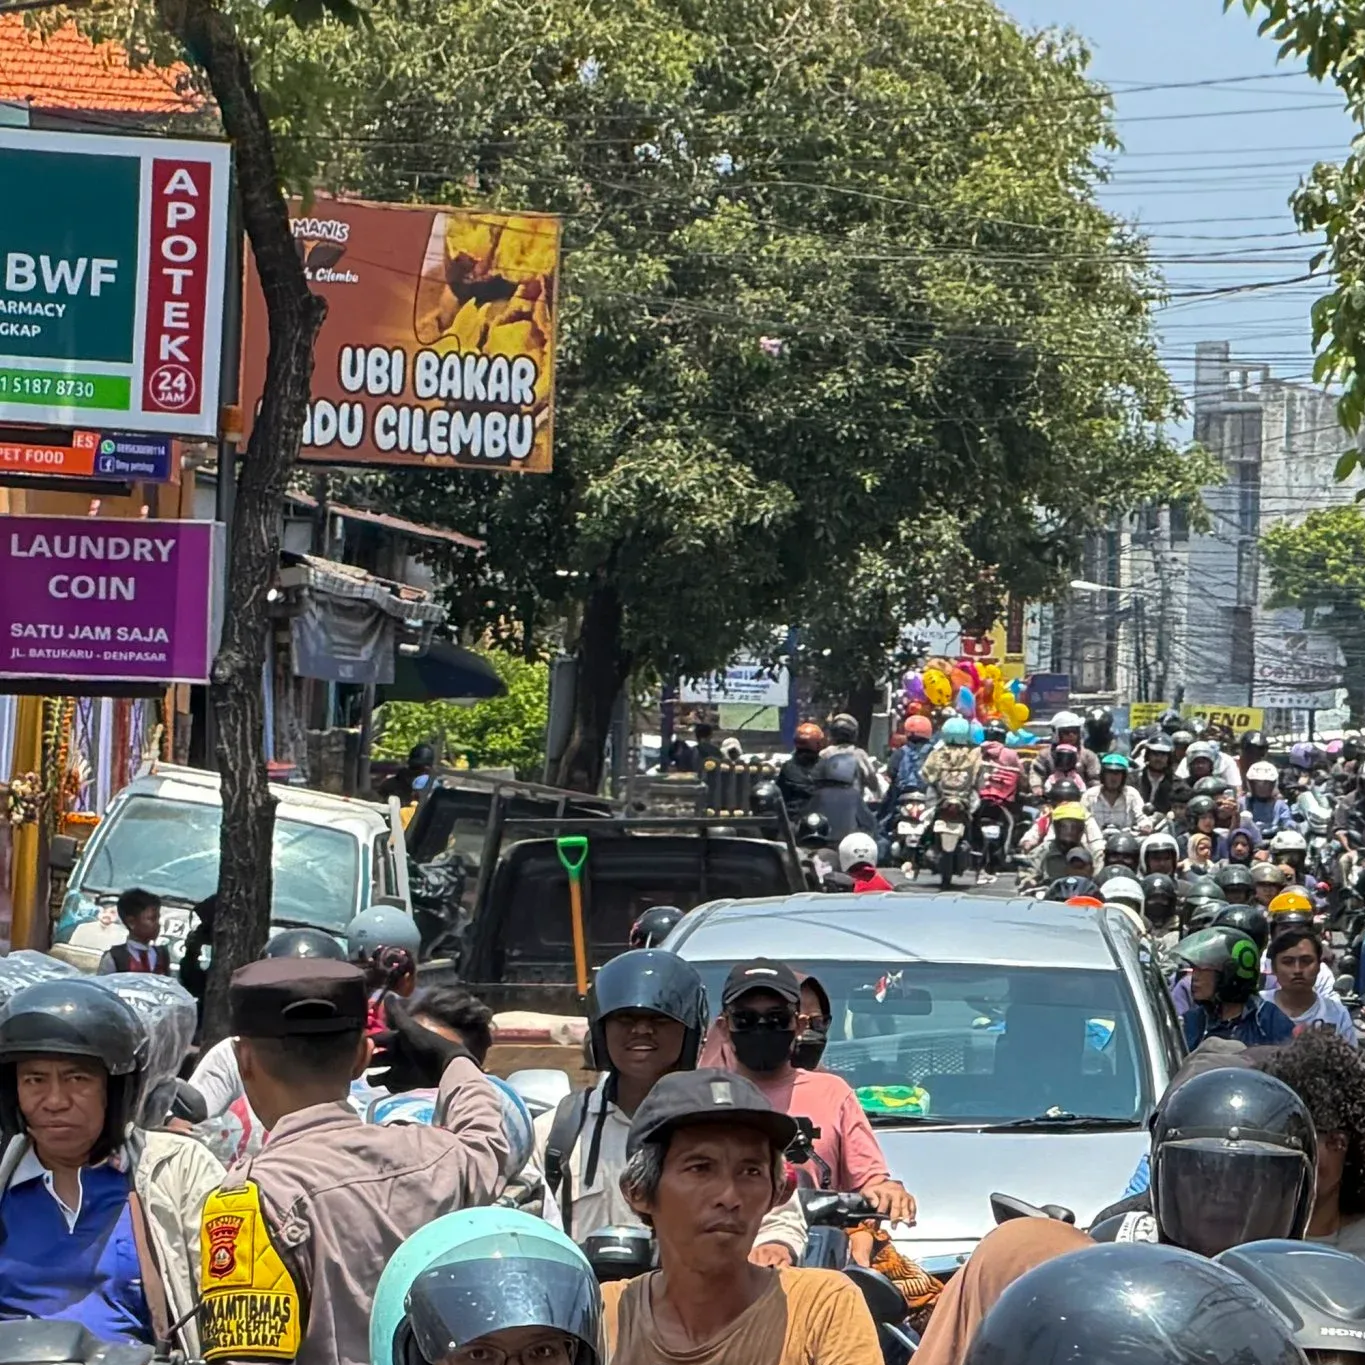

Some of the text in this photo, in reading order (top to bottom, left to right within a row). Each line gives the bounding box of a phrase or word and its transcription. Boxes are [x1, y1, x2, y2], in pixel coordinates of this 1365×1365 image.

[5, 253, 118, 297] BWF
[159, 168, 199, 362] APOTEK
[158, 371, 187, 391] 24
[341, 346, 536, 404] UBI BAKAR
[13, 378, 51, 394] 5187
[56, 380, 94, 397] 8730
[158, 392, 185, 402] JAM
[374, 404, 534, 458] CILEMBU
[26, 450, 64, 465] FOOD
[11, 533, 176, 562] LAUNDRY
[48, 575, 136, 601] COIN
[11, 623, 169, 643] SATU JAM SAJA
[29, 648, 94, 660] BATUKARU
[103, 651, 167, 662] DENPASAR
